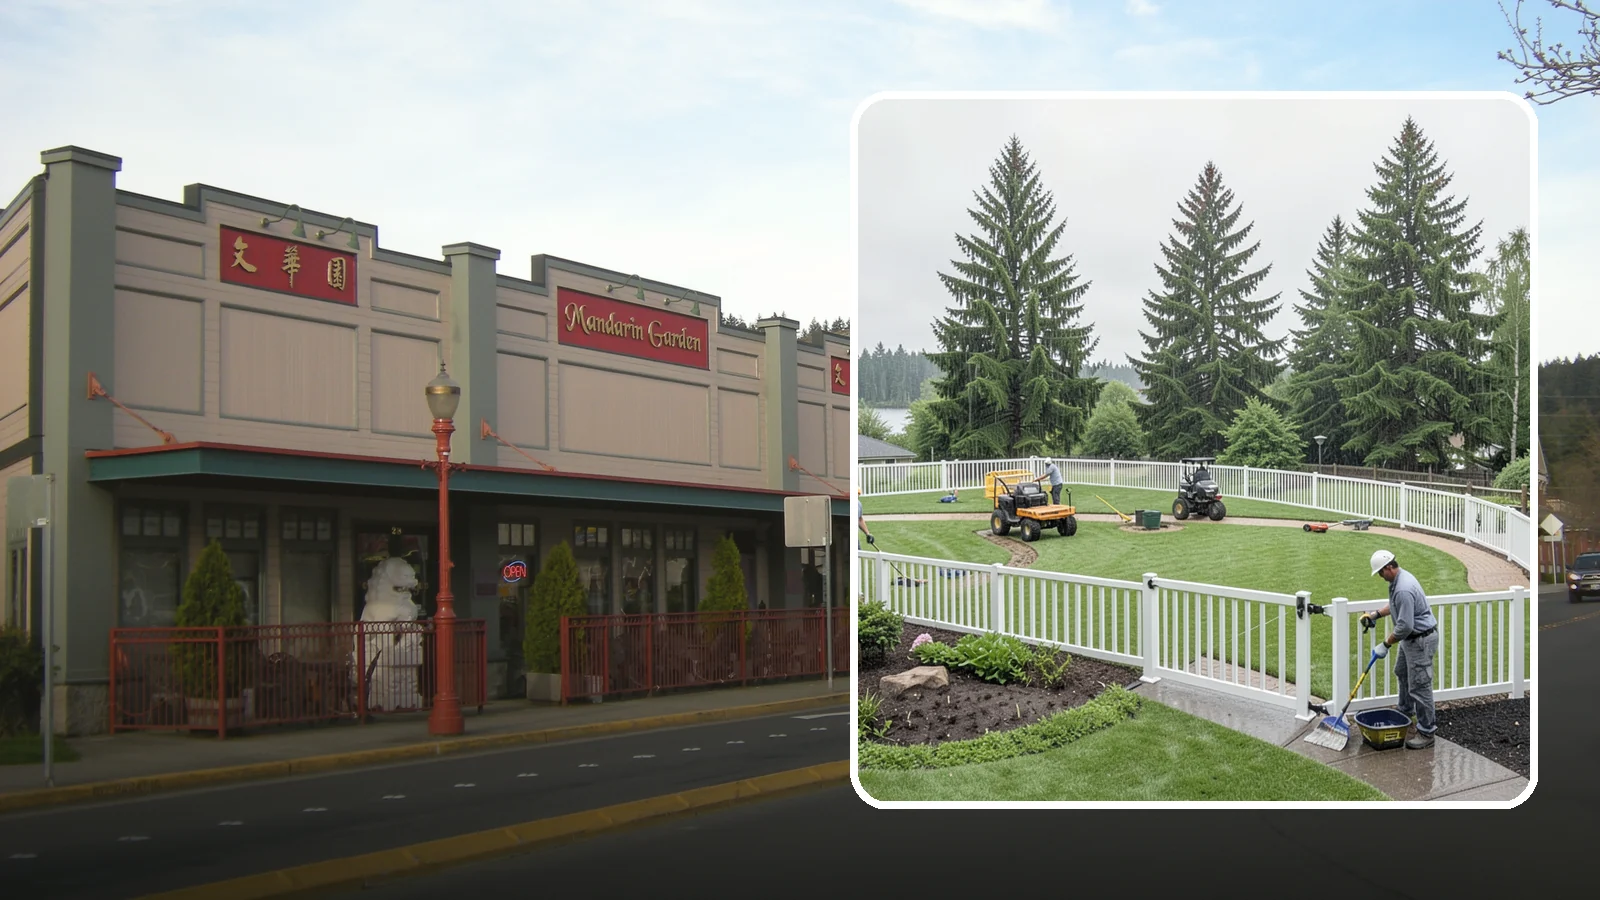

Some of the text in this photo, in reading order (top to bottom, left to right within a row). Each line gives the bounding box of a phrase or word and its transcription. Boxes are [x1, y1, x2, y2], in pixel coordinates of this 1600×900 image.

[231, 236, 346, 290] 文華園
[565, 302, 701, 352] Mandarin Garden
[834, 363, 846, 386] 文
[503, 565, 526, 578] OPEN
